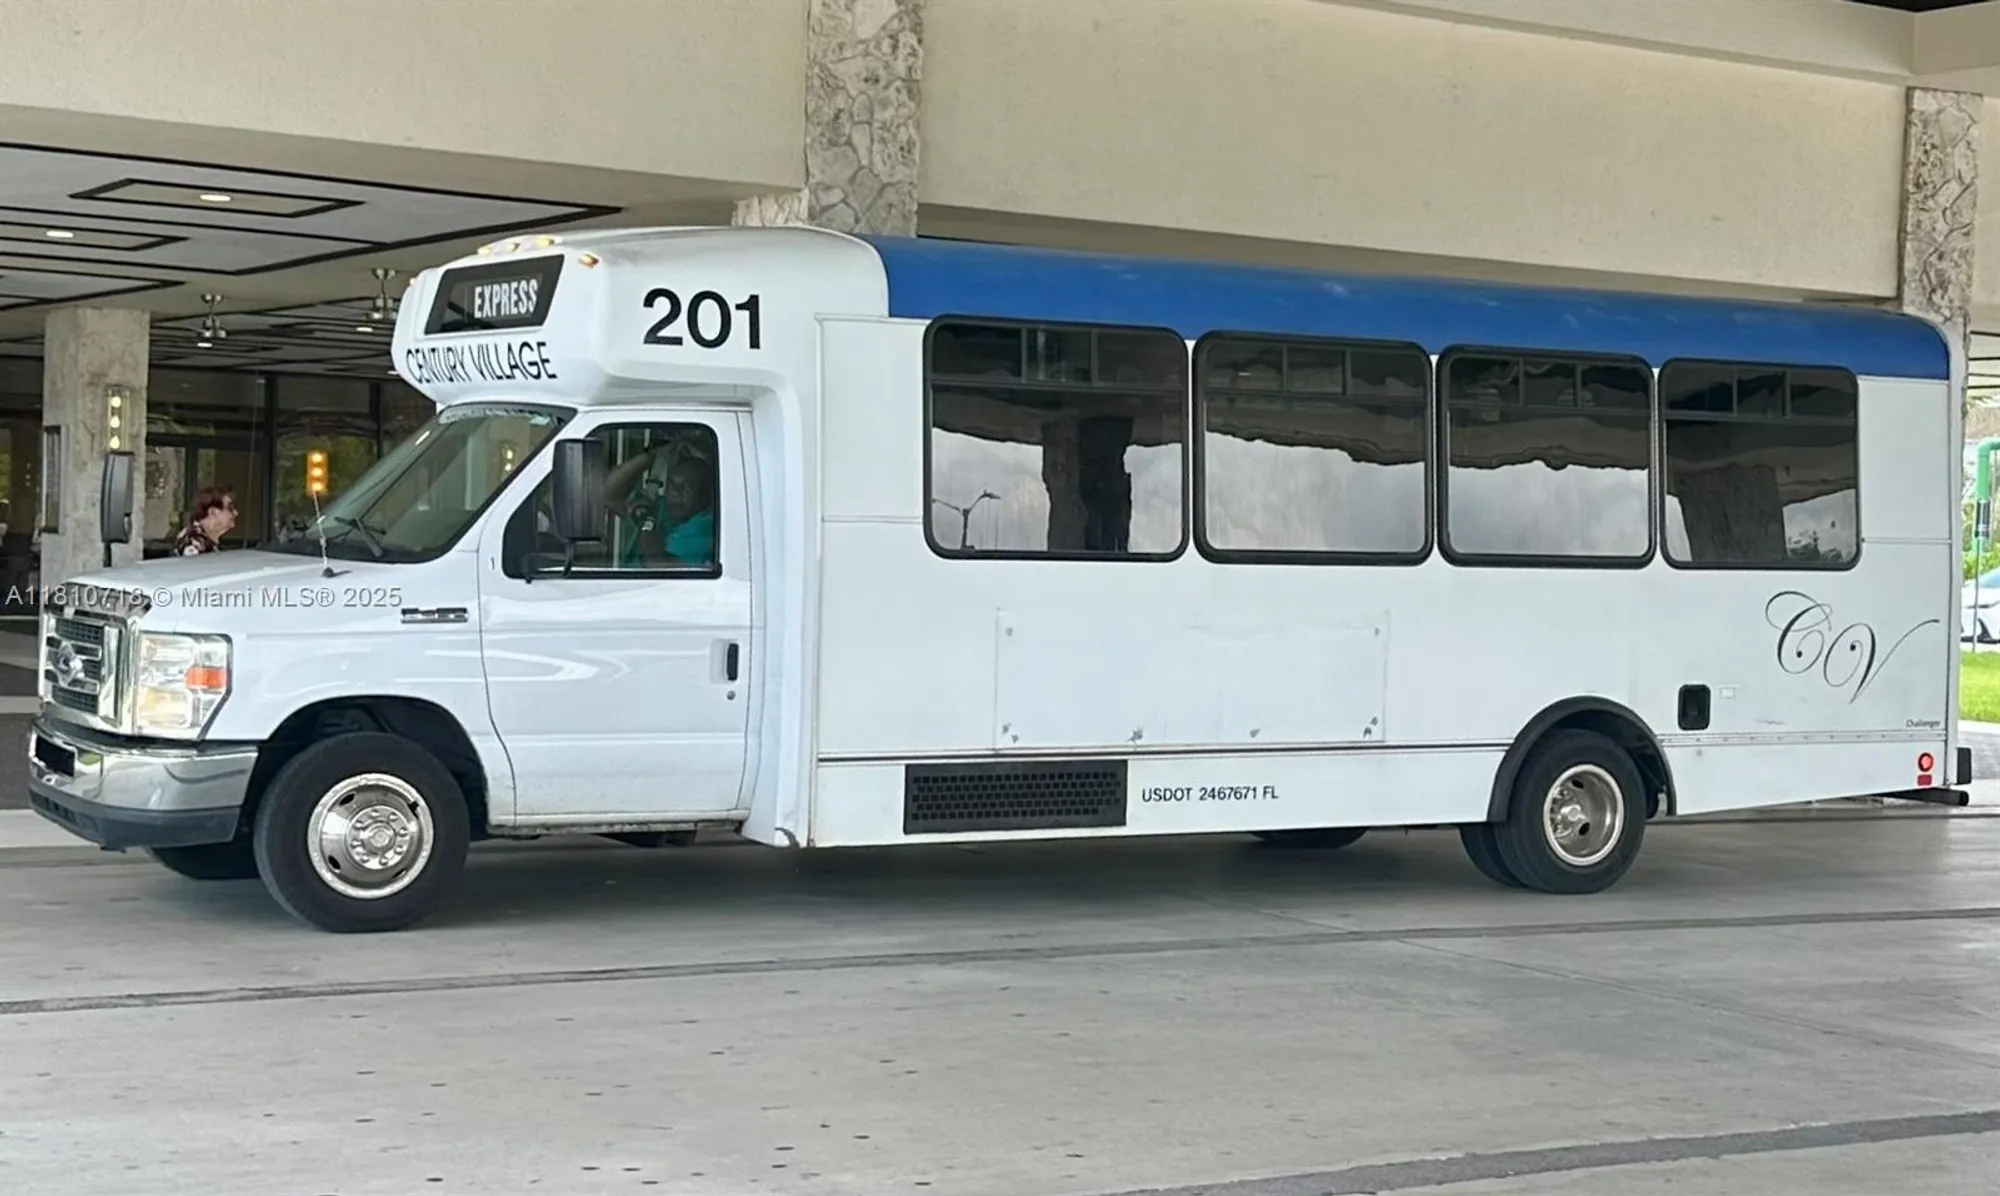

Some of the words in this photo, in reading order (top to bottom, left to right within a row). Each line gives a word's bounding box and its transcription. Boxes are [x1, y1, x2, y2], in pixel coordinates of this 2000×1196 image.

[473, 278, 539, 319] EXPRESS
[641, 287, 762, 350] 201
[405, 347, 474, 385] CENTURY
[468, 341, 558, 382] VILLAGE
[1765, 590, 1941, 704] CV
[1142, 787, 1193, 803] USDOT
[1199, 786, 1257, 801] 2467671
[1262, 785, 1279, 800] FL
